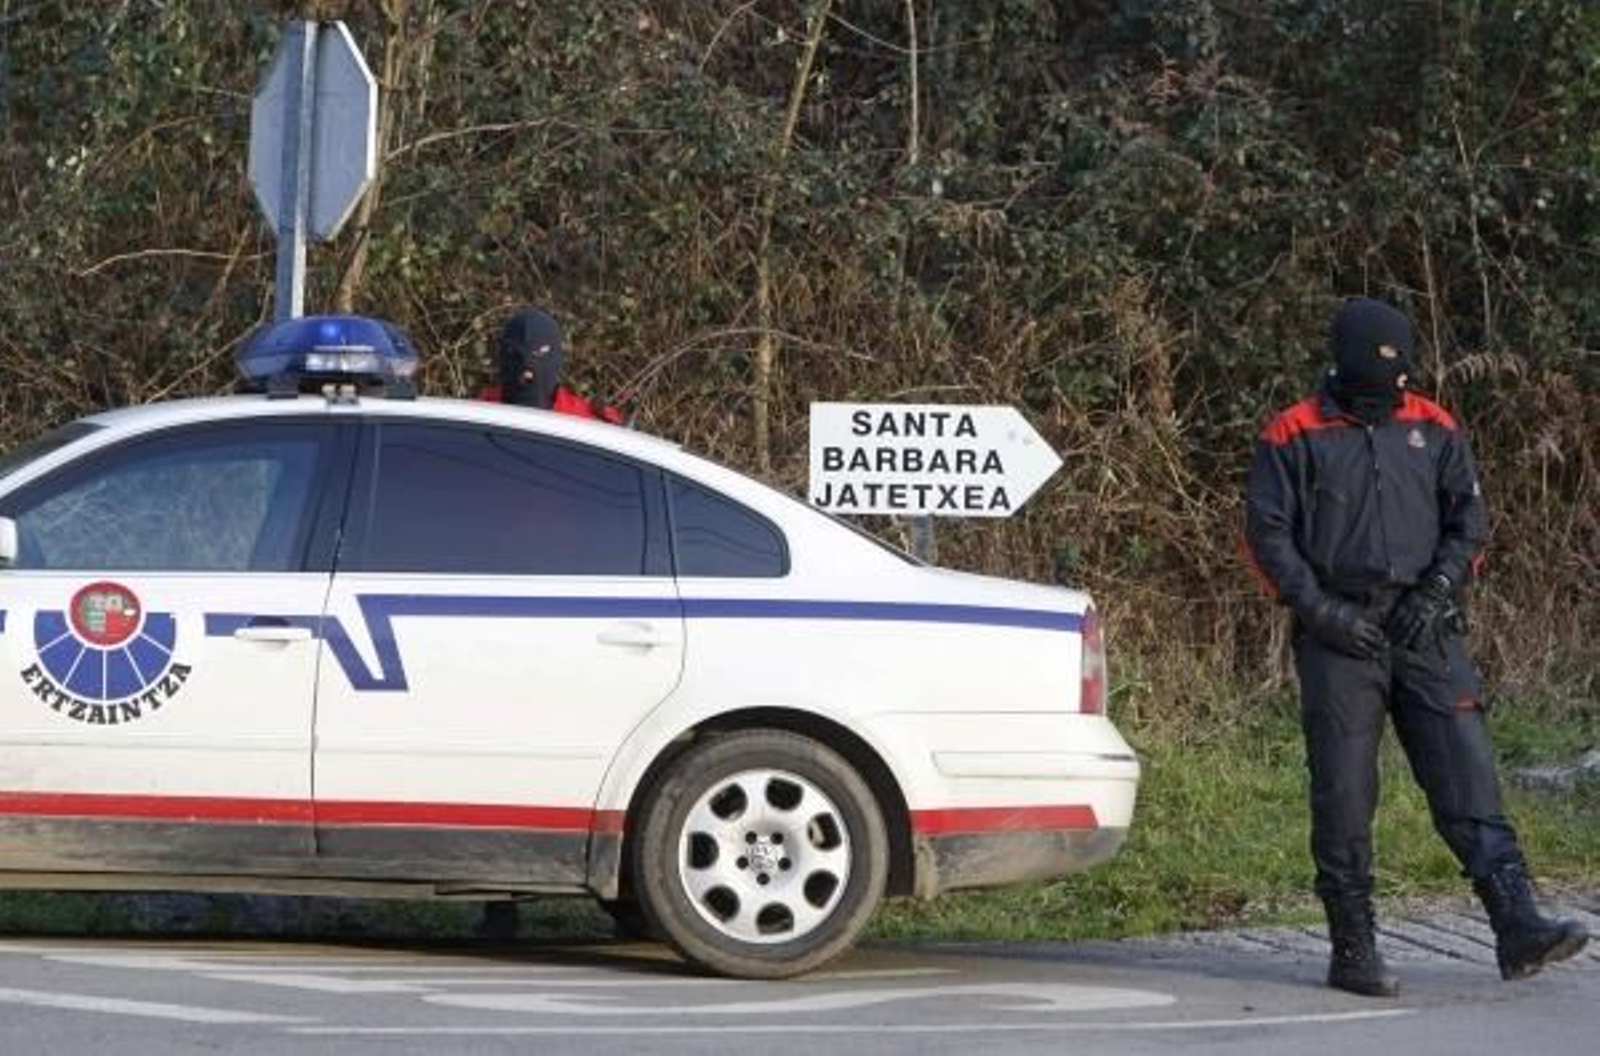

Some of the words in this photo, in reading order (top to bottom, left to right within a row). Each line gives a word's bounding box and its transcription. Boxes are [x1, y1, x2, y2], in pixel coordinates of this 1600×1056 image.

[851, 411, 978, 437] SANTA
[823, 447, 1004, 474] BARBARA
[815, 483, 1011, 510] JATETXEA
[20, 662, 192, 725] ERTZAINTZA
